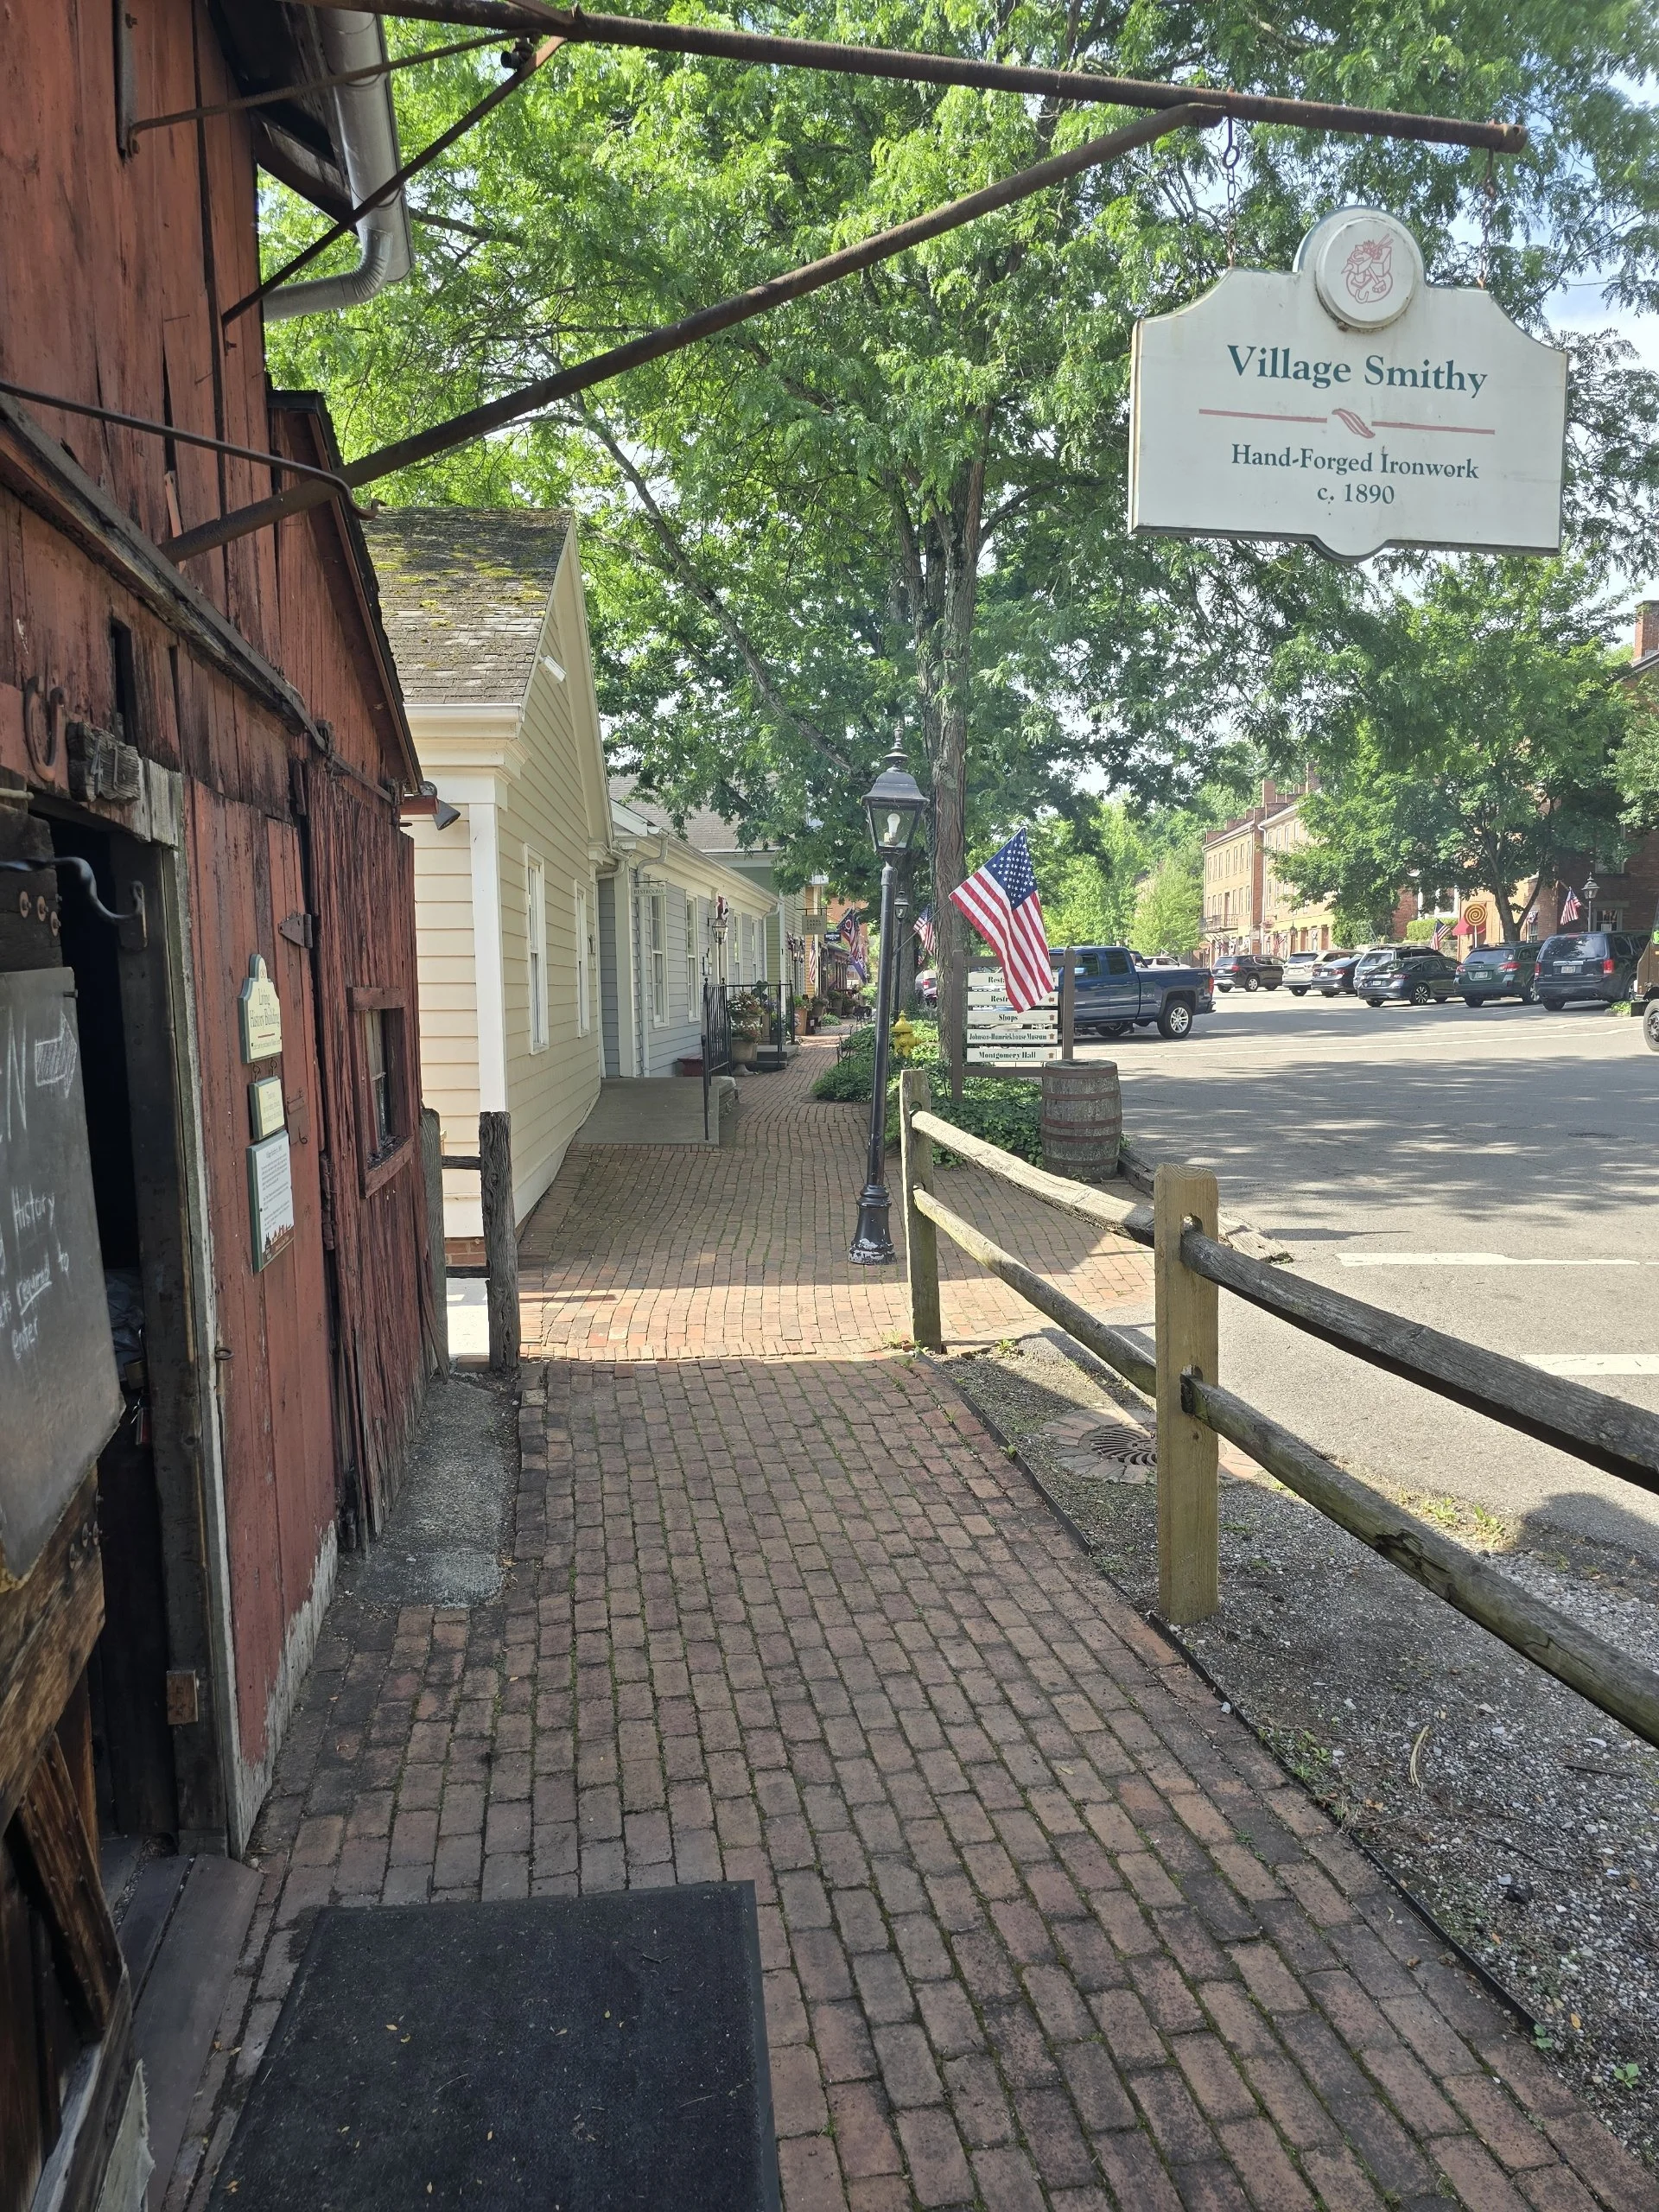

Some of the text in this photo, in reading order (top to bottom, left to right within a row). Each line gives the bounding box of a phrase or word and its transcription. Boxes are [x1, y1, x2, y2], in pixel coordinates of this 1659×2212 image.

[1227, 344, 1488, 398] Village Smithy
[1231, 443, 1480, 479] Hand-Forged Ironwork
[1317, 483, 1395, 505] c. 1890
[257, 988, 270, 1009] Living
[249, 1007, 280, 1029] History Building
[998, 1014, 1019, 1022] Shops
[978, 1052, 1020, 1060] Montgomery
[12, 1185, 55, 1234] History
[16, 1251, 51, 1307] required
[56, 1239, 70, 1274] to
[11, 1315, 39, 1361] enter
